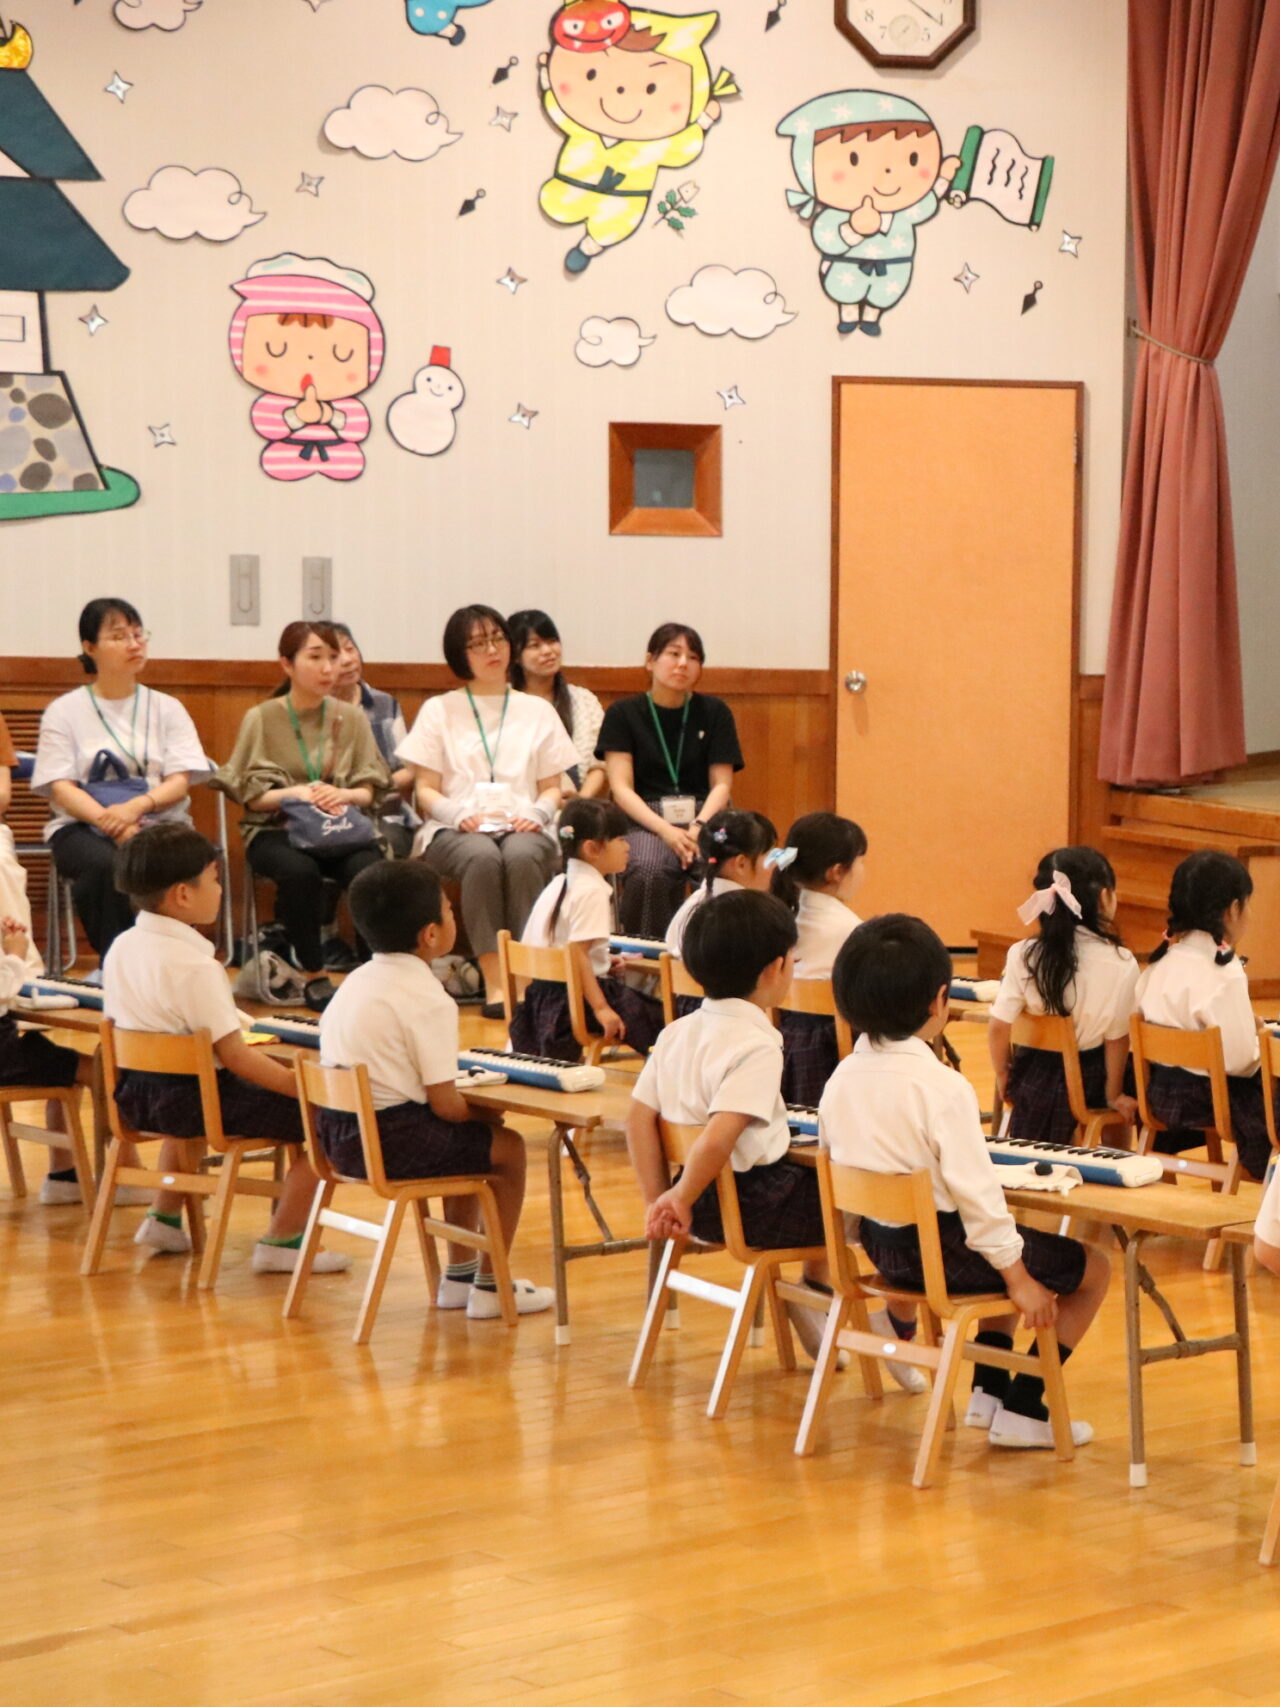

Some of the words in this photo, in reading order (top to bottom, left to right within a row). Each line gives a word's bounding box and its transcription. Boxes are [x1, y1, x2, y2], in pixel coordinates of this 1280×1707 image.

[864, 9, 874, 22] 8
[879, 25, 888, 39] 7
[921, 26, 931, 41] 5
